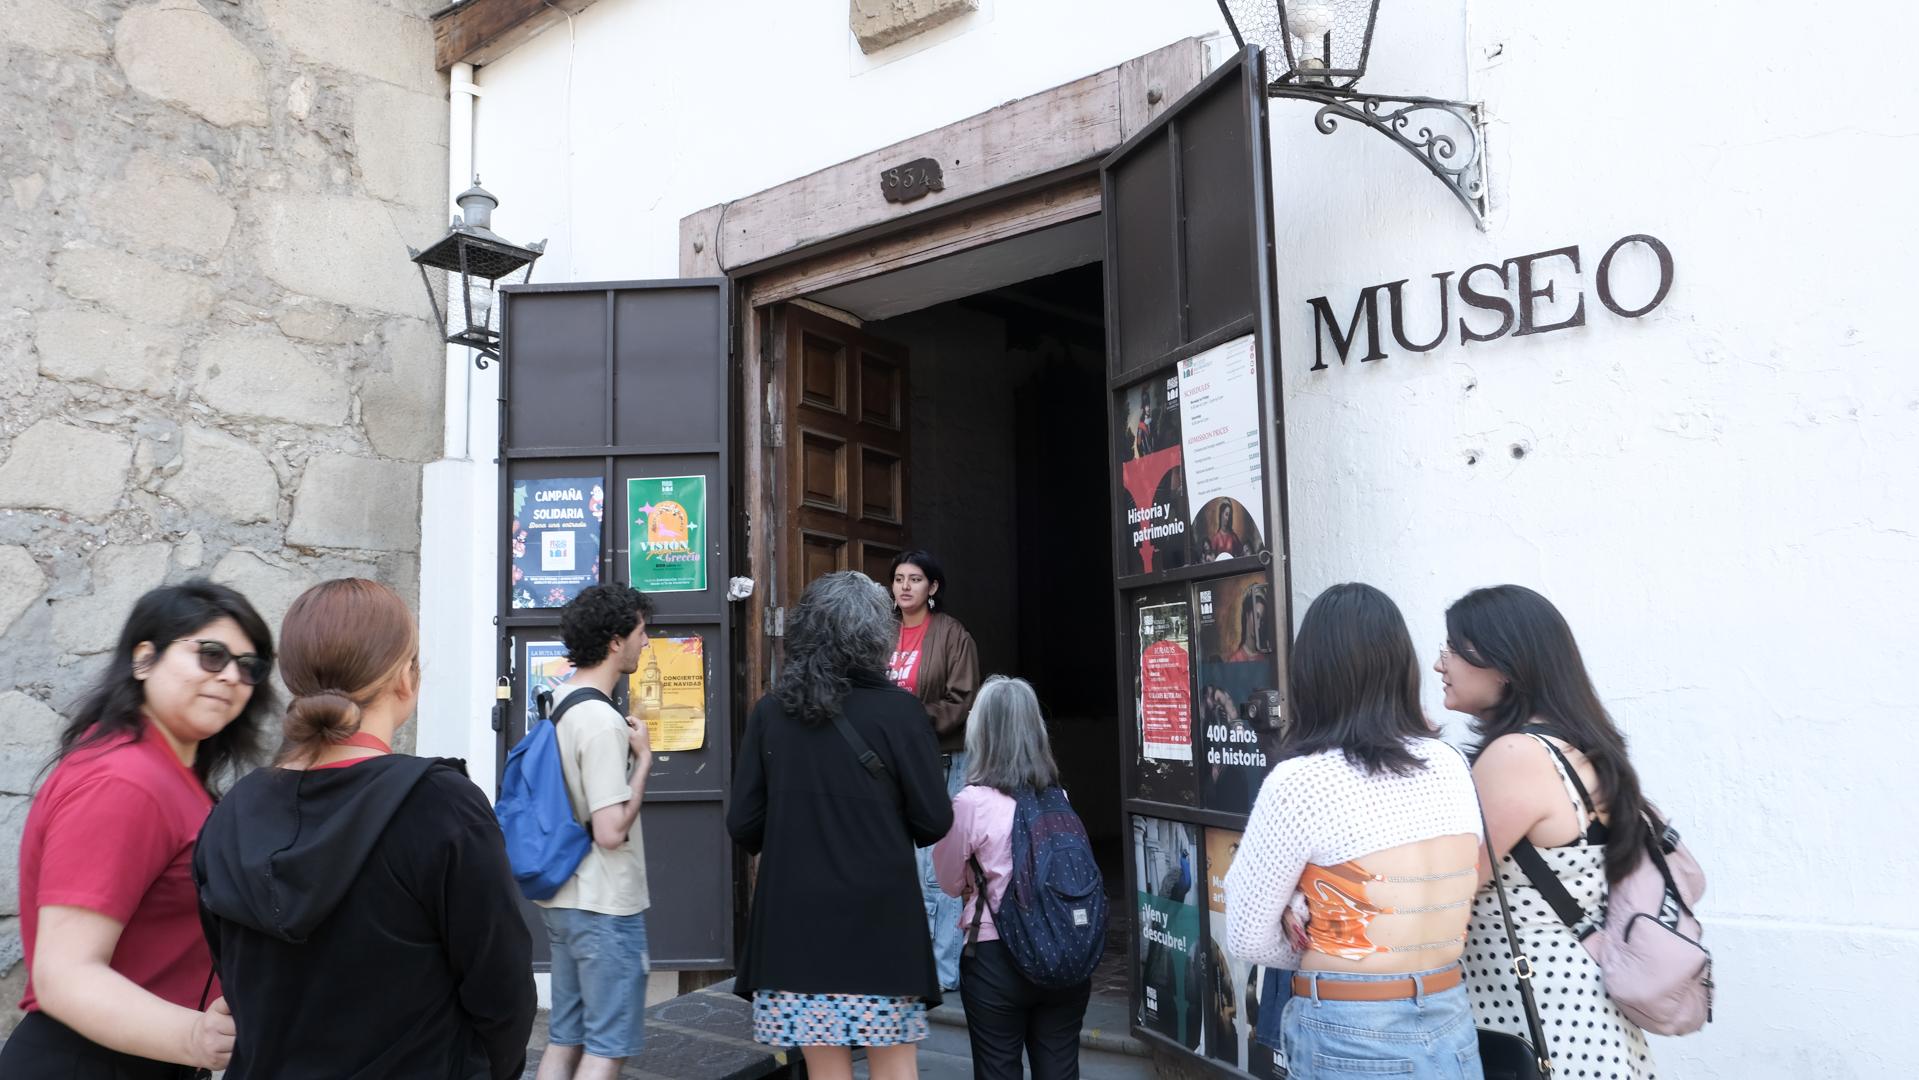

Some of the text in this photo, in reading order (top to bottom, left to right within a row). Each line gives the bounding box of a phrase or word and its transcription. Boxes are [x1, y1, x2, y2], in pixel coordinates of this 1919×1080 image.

[888, 167, 929, 188] 834
[1306, 233, 1674, 371] MUSEO
[535, 488, 583, 502] CAMPAÑA
[533, 508, 584, 520] SOLIDARIA
[1128, 502, 1170, 525] Historia y
[1133, 518, 1185, 547] patrimonio
[640, 538, 689, 552] VISIÓN
[1207, 724, 1258, 743] 400 años
[1207, 747, 1267, 767] de historia
[1142, 903, 1169, 929] ¡Ven y
[1143, 923, 1187, 953] descubre!
